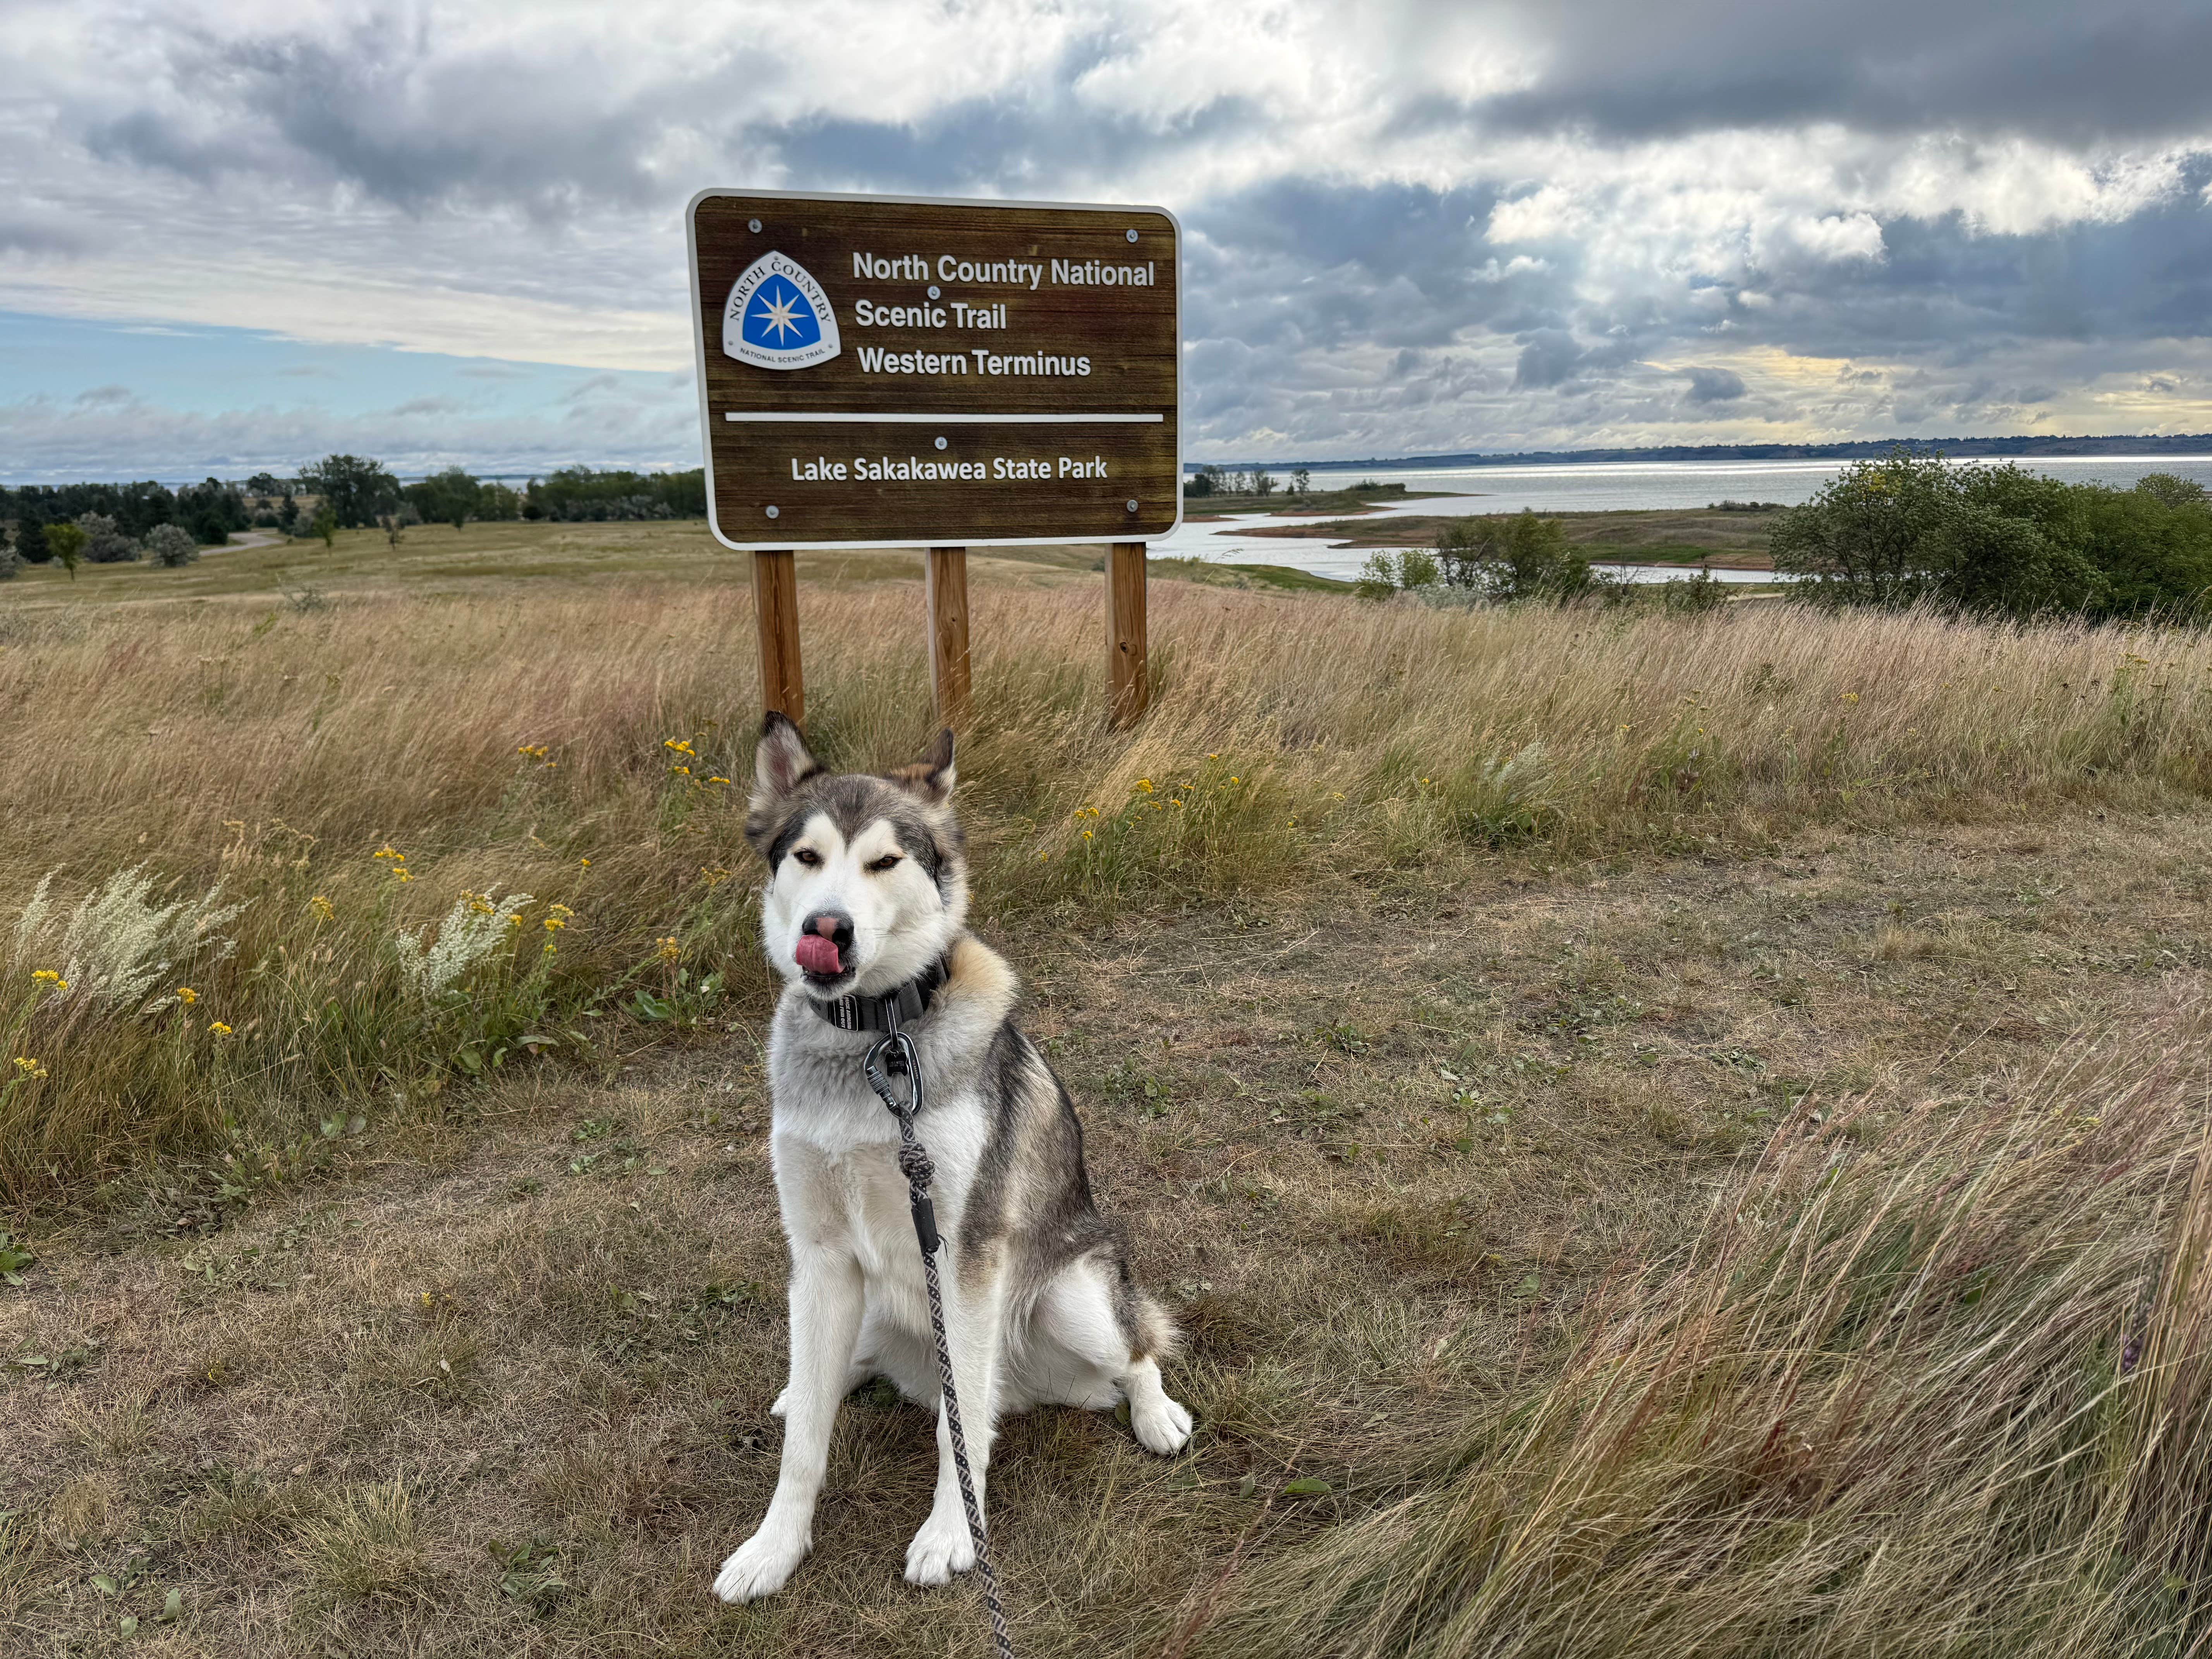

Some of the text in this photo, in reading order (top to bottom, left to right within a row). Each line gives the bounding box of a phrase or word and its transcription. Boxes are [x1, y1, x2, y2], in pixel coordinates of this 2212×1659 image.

[853, 252, 1154, 290] North Country National
[729, 261, 831, 323] NORTH COUNTRY
[855, 299, 1006, 329] Scenic Trail
[740, 347, 826, 363] NATIONAL SCENIC TRAIL
[856, 347, 1091, 376] Western Terminus
[791, 455, 1108, 481] Lake Sakakawea State Park
